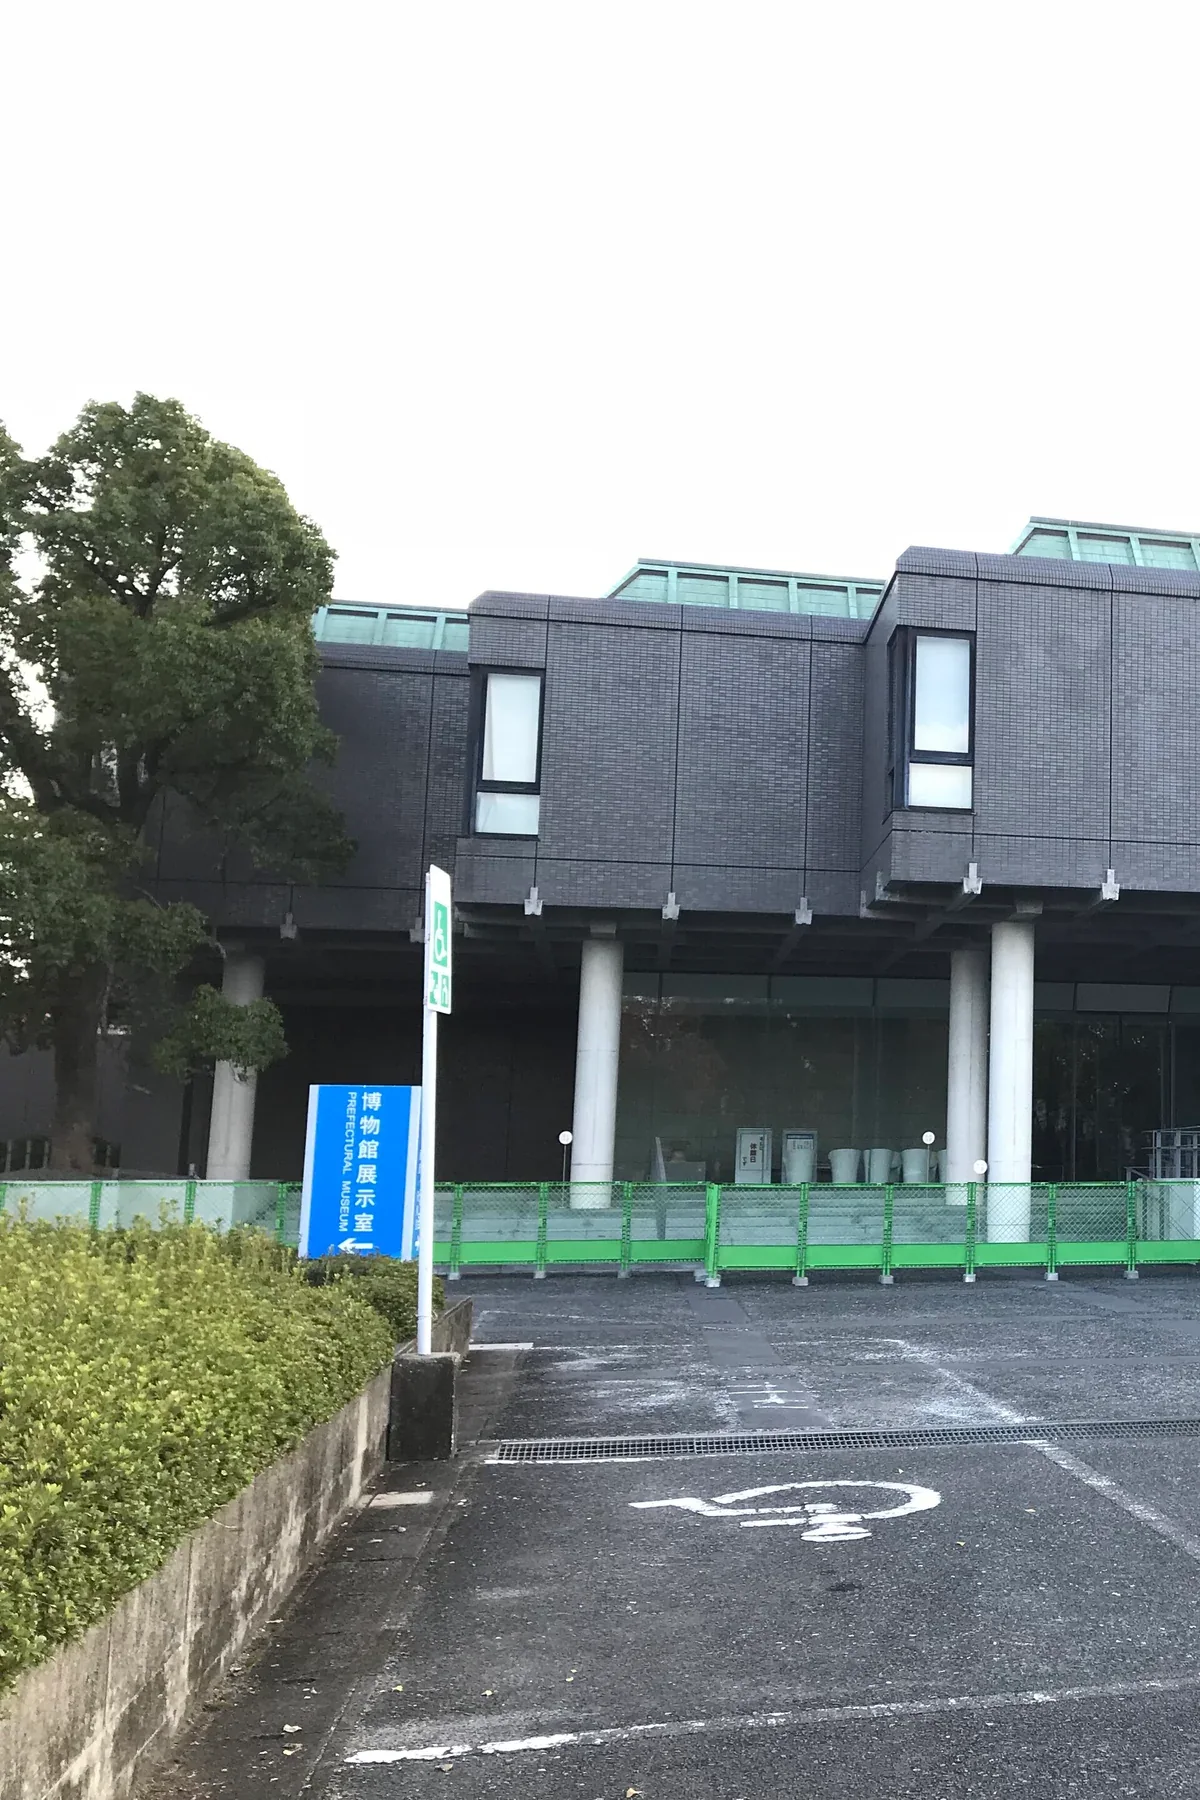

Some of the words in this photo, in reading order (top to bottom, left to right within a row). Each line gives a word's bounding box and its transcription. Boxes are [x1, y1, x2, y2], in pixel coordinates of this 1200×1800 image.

[342, 1091, 358, 1175] PREFECTURAL
[353, 1091, 382, 1232] 博物館展示室
[338, 1180, 352, 1232] MUSEUM
